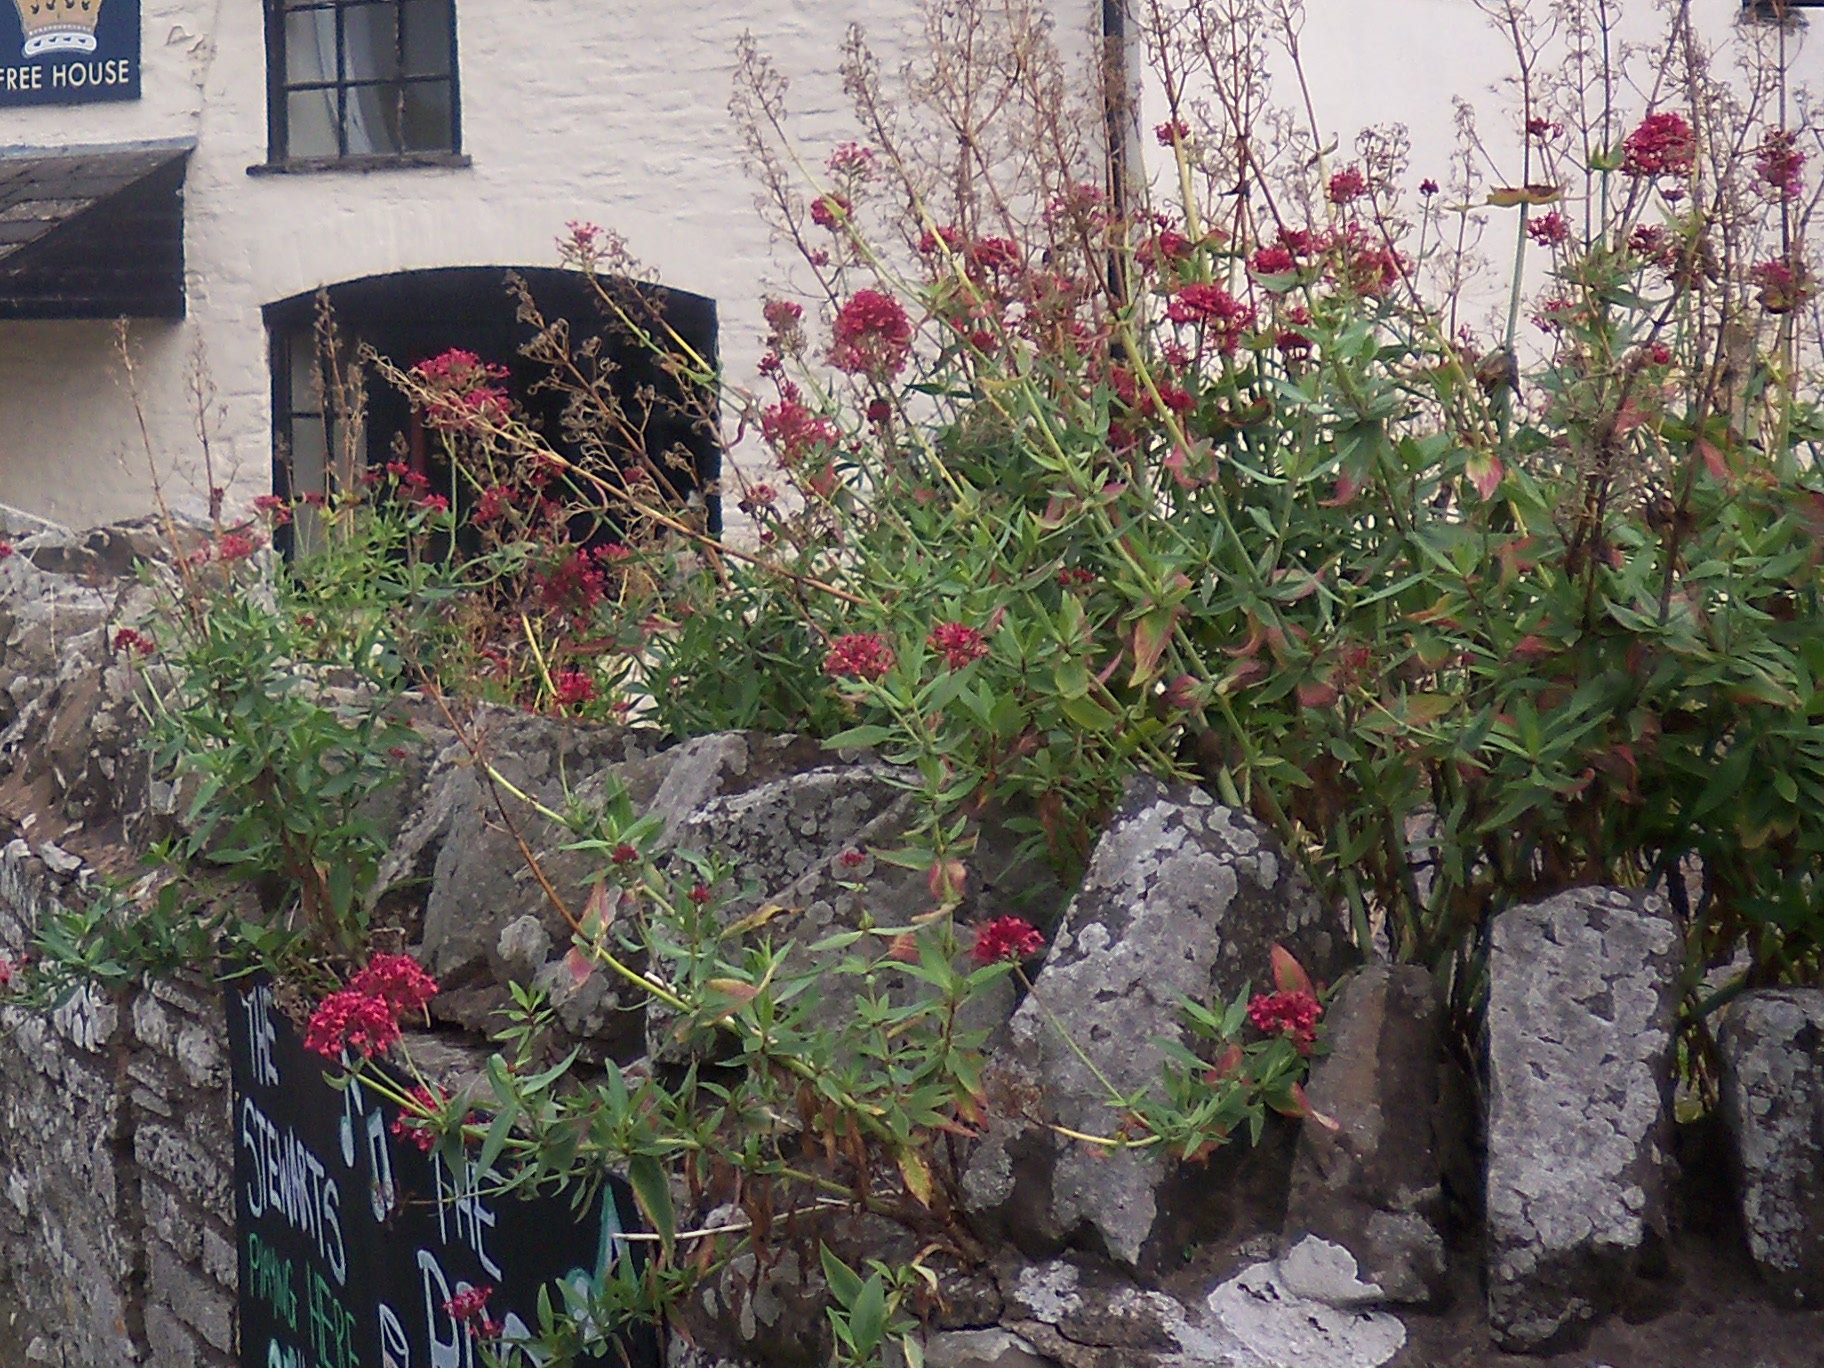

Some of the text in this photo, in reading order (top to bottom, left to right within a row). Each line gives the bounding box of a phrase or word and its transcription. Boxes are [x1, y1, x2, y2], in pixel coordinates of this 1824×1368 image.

[52, 59, 129, 88] HOUSE
[241, 985, 279, 1086] THE
[243, 1097, 346, 1287] STEWARTS
